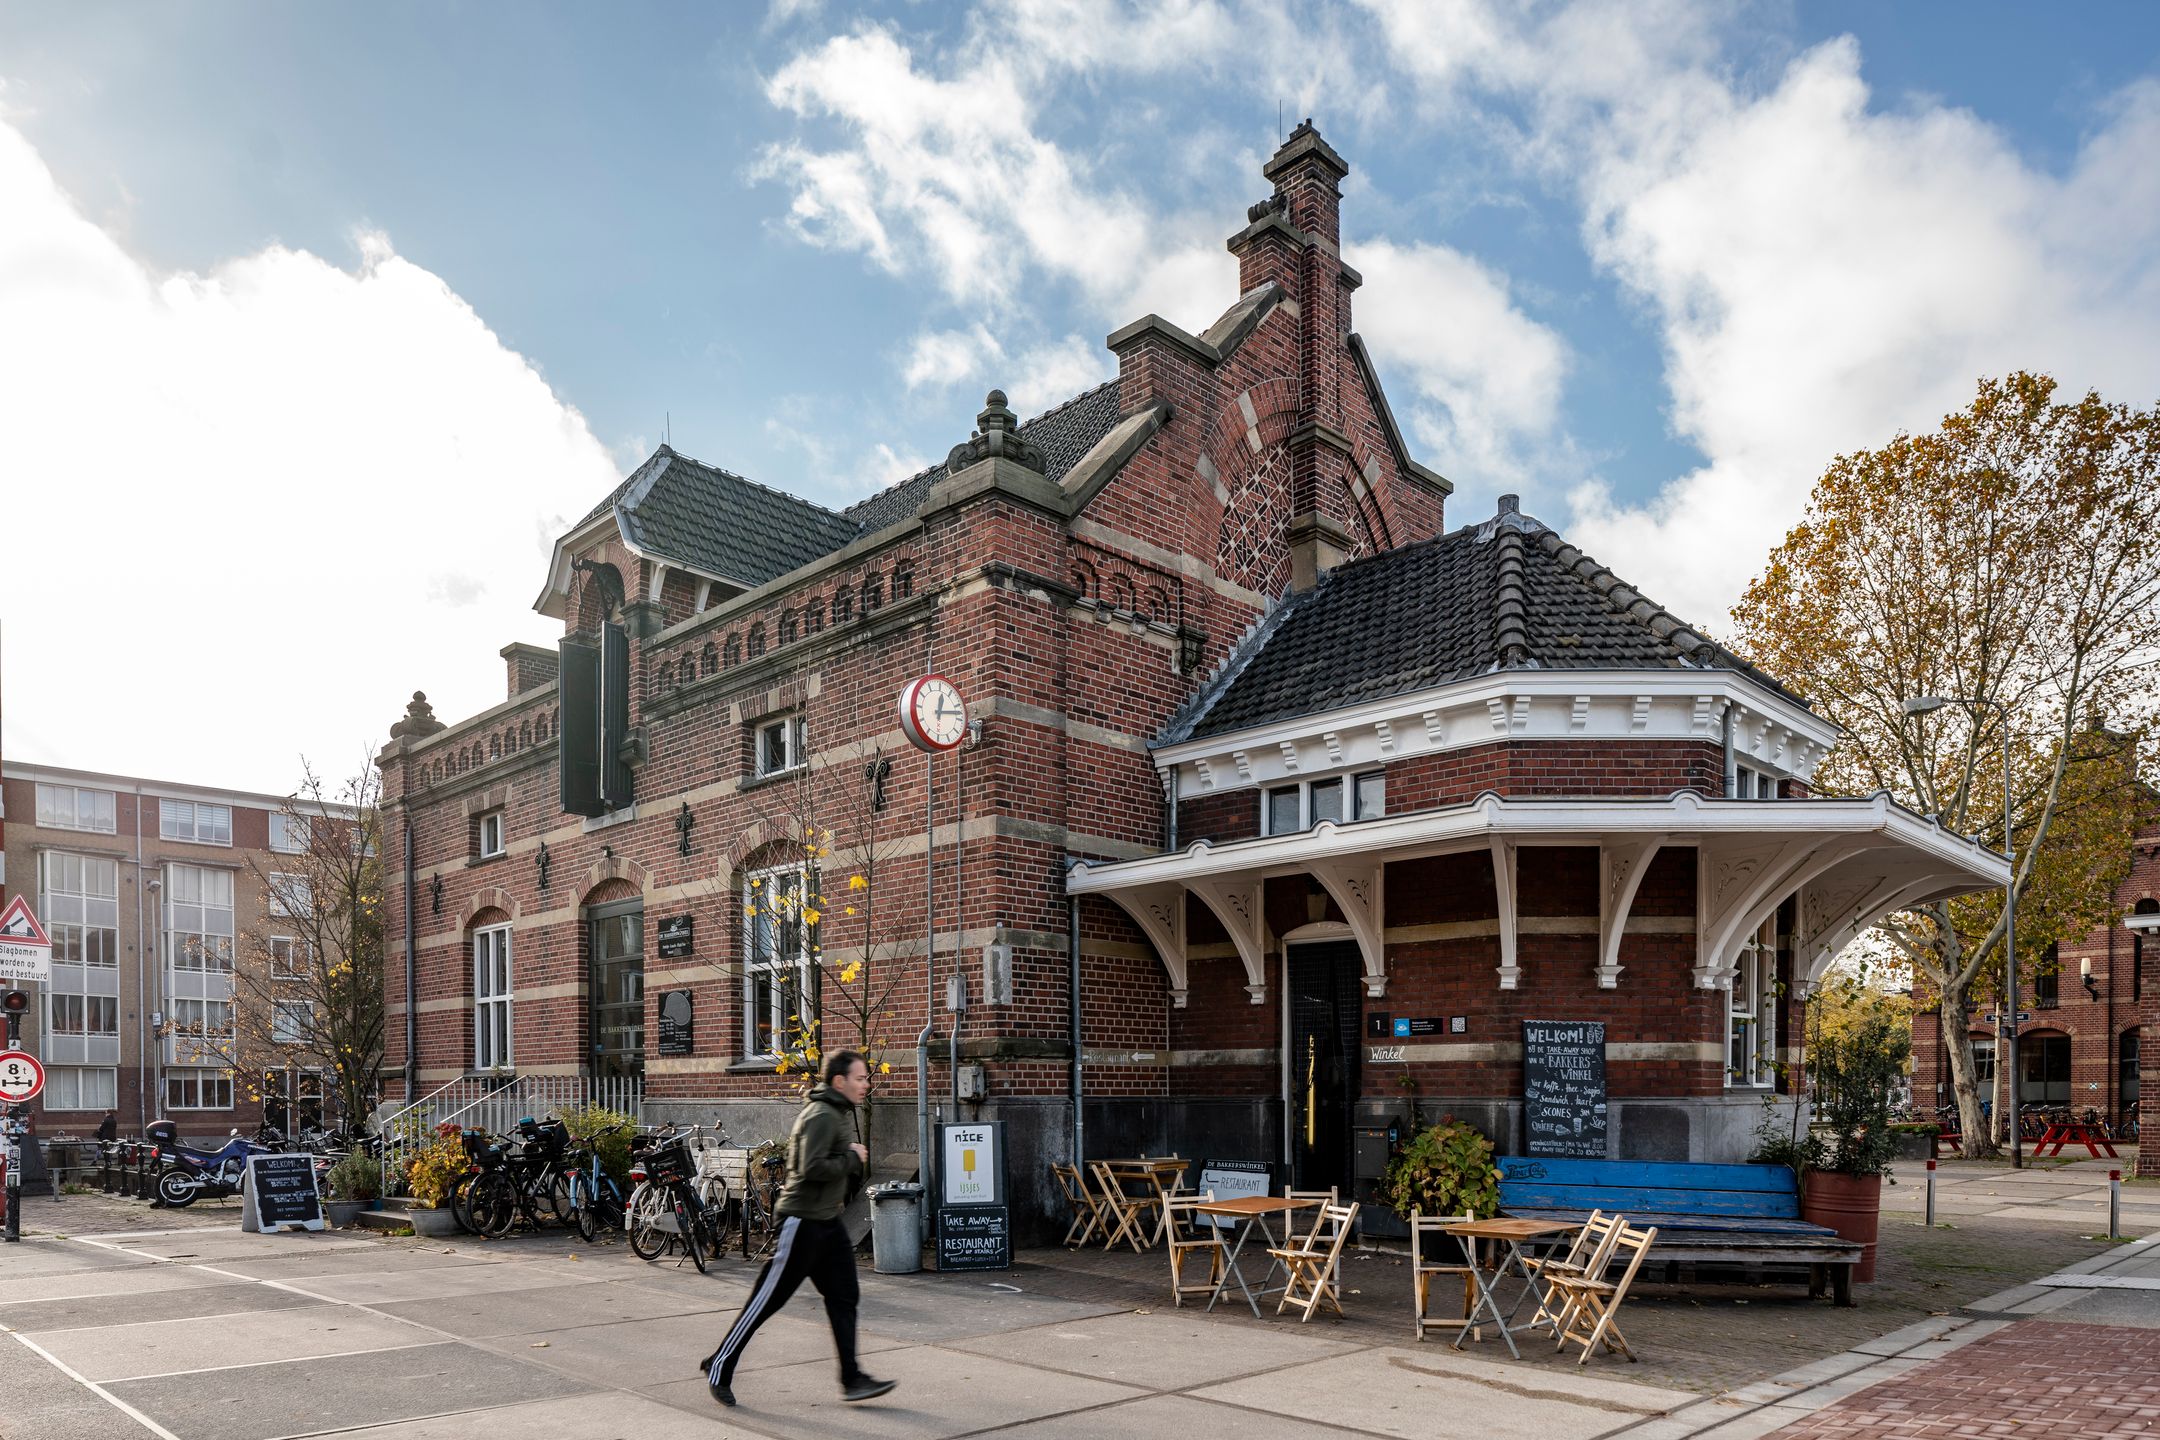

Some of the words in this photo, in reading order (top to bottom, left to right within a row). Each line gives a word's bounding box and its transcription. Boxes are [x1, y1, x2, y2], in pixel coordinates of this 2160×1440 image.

[0, 945, 38, 956] Slagbomen
[0, 958, 25, 967] worden
[27, 961, 36, 969] op
[0, 969, 14, 977] and
[16, 969, 48, 980] bestuurd
[1376, 1019, 1381, 1030] 1
[1527, 1027, 1584, 1043] WELKOM!
[1371, 1045, 1406, 1060] Winkel
[1580, 1047, 1596, 1055] SHOP
[8, 1063, 19, 1075] 8
[23, 1067, 27, 1075] t
[1540, 1106, 1572, 1119] SCONES
[1220, 1176, 1261, 1191] RESTAURANT
[967, 1216, 991, 1226] AWAY
[945, 1237, 1002, 1250] RESTAURANT
